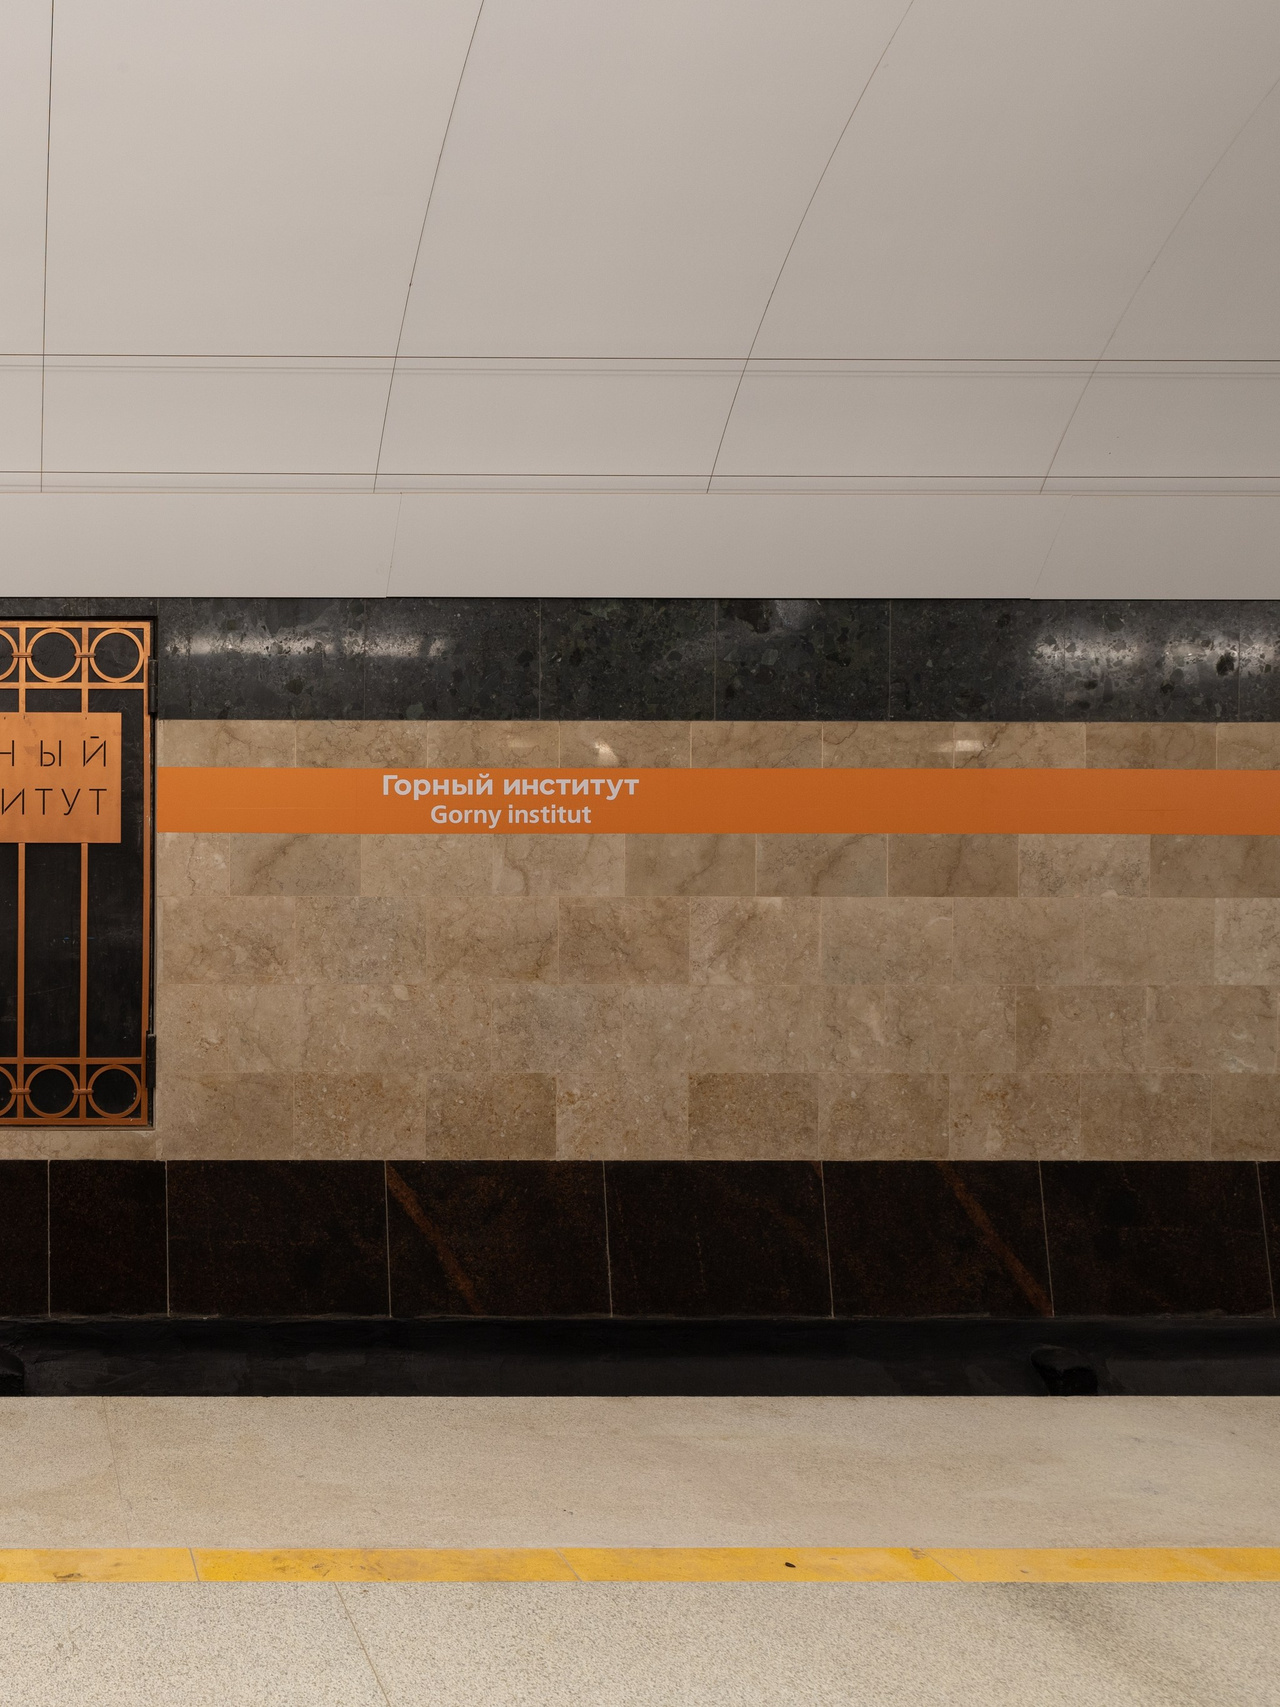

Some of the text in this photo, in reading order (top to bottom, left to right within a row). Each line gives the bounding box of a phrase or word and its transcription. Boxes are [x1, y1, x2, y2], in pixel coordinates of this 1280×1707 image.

[382, 773, 640, 801] Горный институт
[430, 804, 592, 829] Gorny institut
